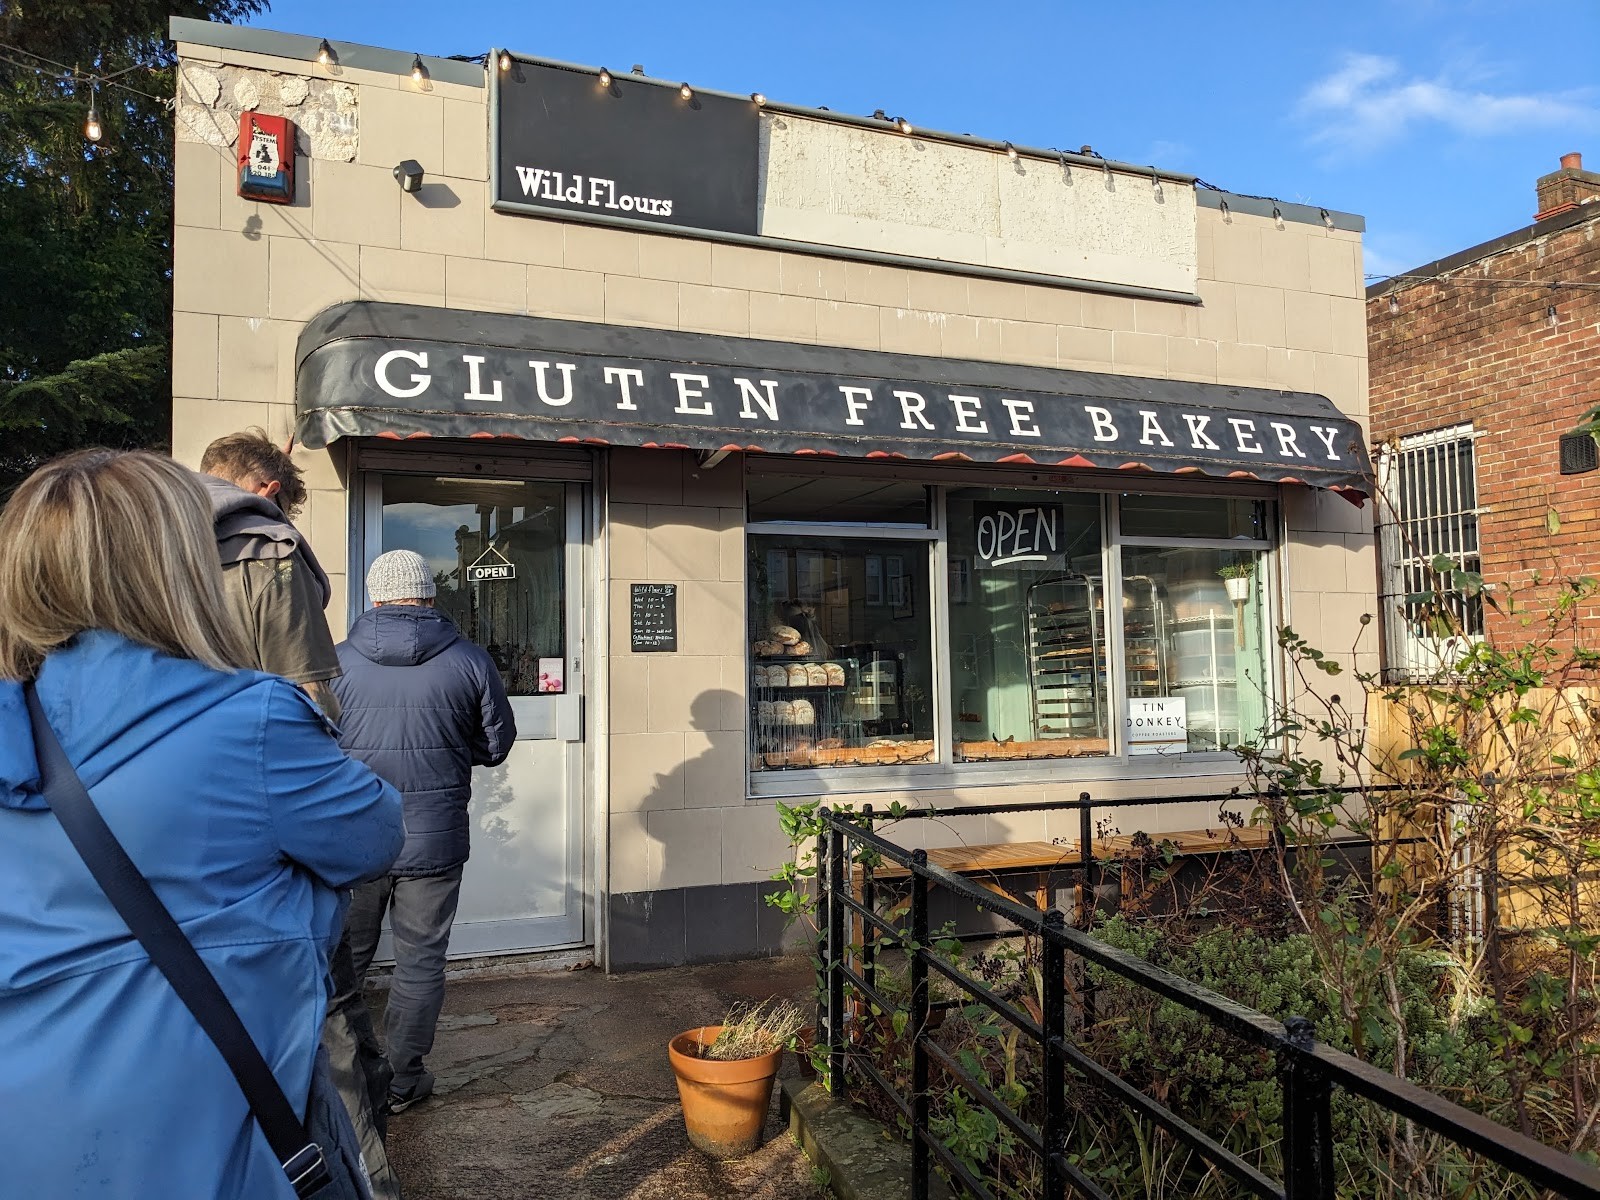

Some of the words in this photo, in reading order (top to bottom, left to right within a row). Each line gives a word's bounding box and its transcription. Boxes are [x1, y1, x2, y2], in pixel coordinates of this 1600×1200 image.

[516, 166, 584, 204] Wild
[588, 177, 673, 217] Flours
[374, 350, 779, 421] GLUTEN
[839, 385, 1040, 437] FREE
[1084, 406, 1341, 461] BAKERY
[978, 507, 1056, 560] OPEN
[475, 567, 508, 578] OPEN
[1126, 716, 1181, 728] DONKEY
[1142, 702, 1164, 712] TIN
